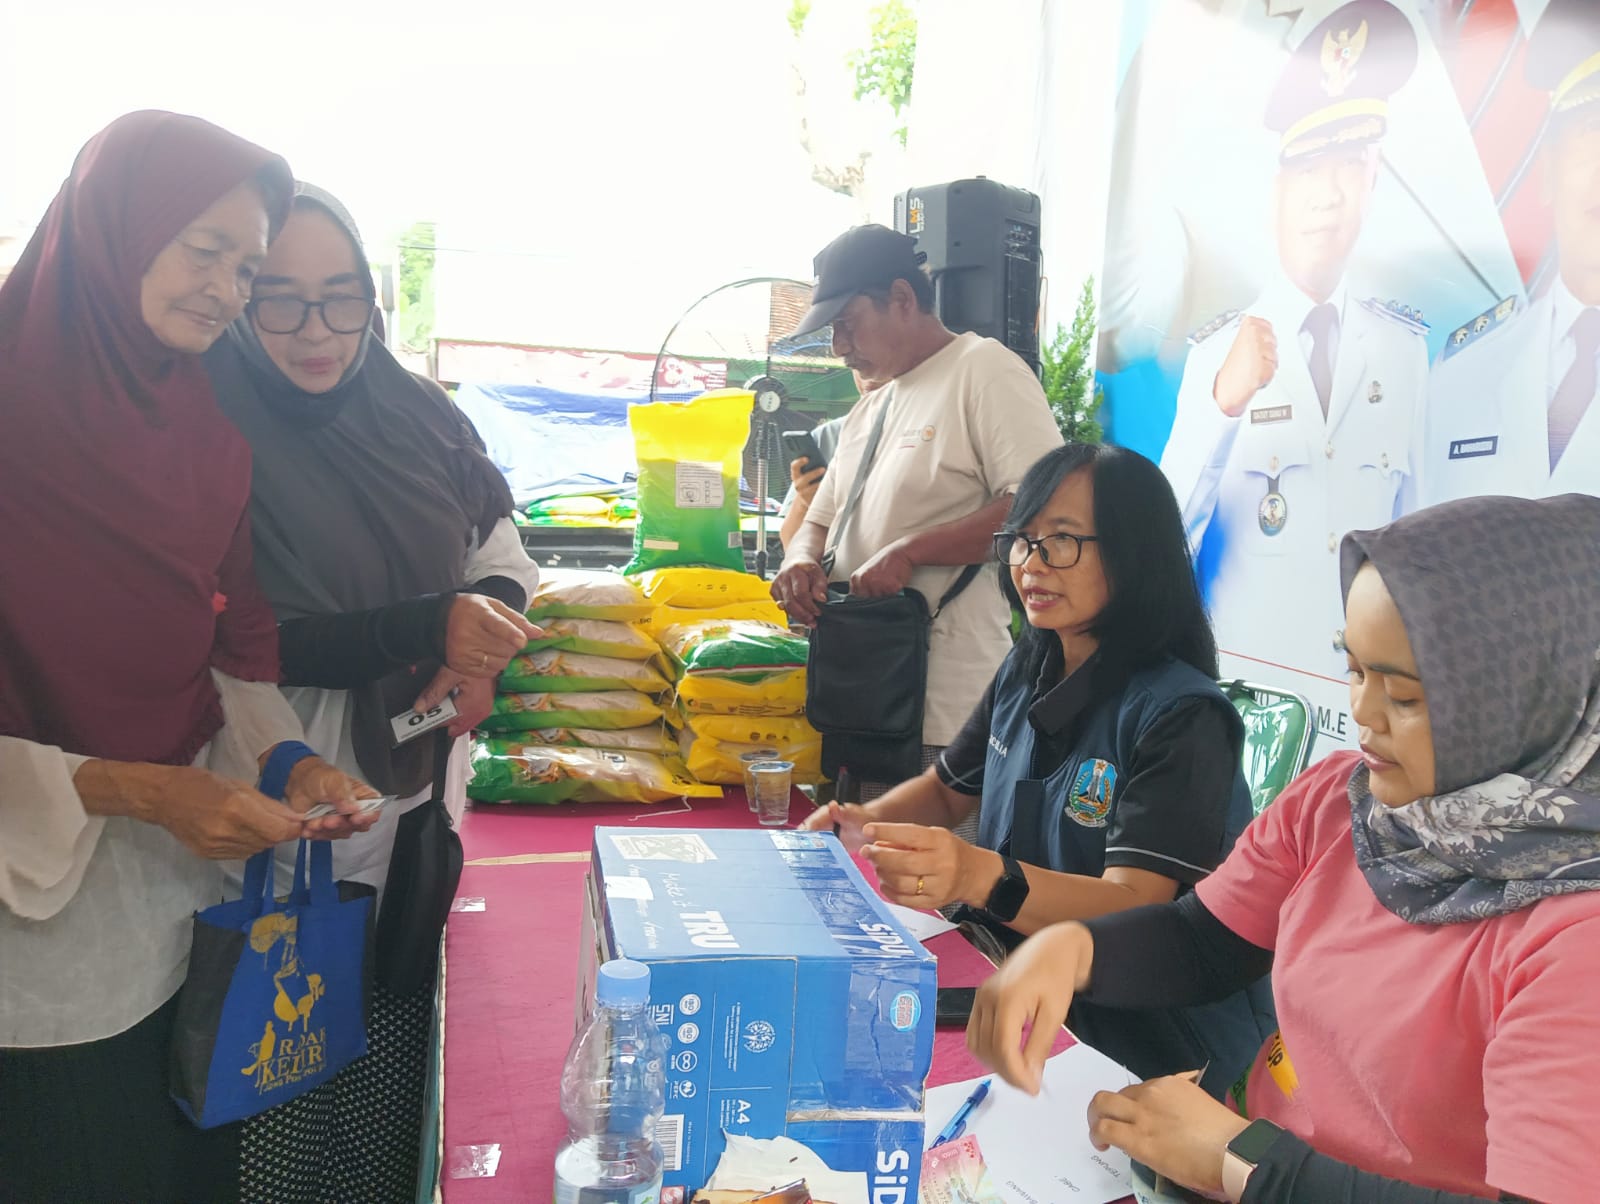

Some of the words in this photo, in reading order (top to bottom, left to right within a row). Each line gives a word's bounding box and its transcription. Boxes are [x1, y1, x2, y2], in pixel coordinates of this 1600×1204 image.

[408, 705, 442, 727] 05
[680, 910, 740, 949] TRU
[655, 1004, 670, 1025] SNI
[737, 1099, 751, 1125] A4
